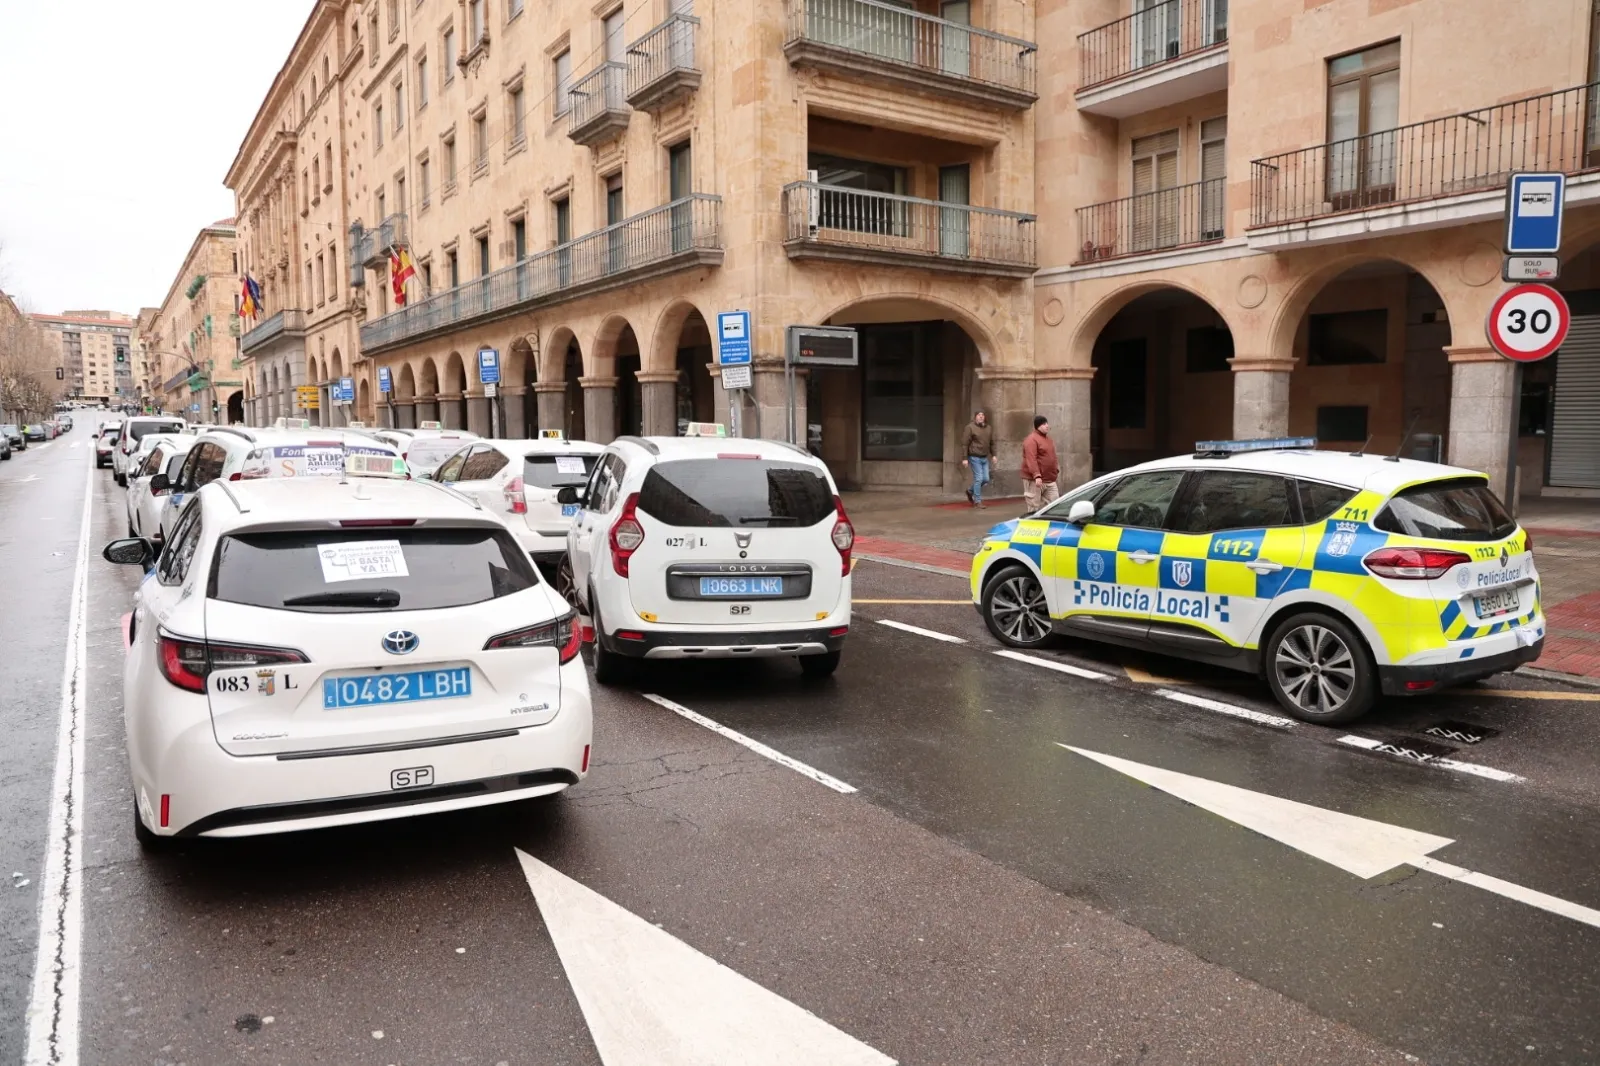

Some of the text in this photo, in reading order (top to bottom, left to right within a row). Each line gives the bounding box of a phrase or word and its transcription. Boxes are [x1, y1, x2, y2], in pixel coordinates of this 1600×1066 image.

[1506, 308, 1552, 334] 30
[333, 386, 341, 398] P
[307, 454, 342, 462] STOP
[1344, 507, 1369, 521] 711
[666, 537, 708, 547] 027 L
[1221, 539, 1255, 556] 112
[1478, 539, 1520, 558] 112 711
[358, 556, 392, 565] BASTA
[360, 565, 377, 573] YA
[711, 579, 779, 592] 0663 LNK
[1089, 583, 1209, 619] Policía Local
[1481, 595, 1501, 612] 5650
[731, 605, 750, 615] SP
[216, 674, 298, 692] 083 L
[342, 675, 410, 704] 0482
[418, 669, 468, 698] LBH
[510, 704, 543, 715] HYBRID
[396, 768, 429, 786] SP
